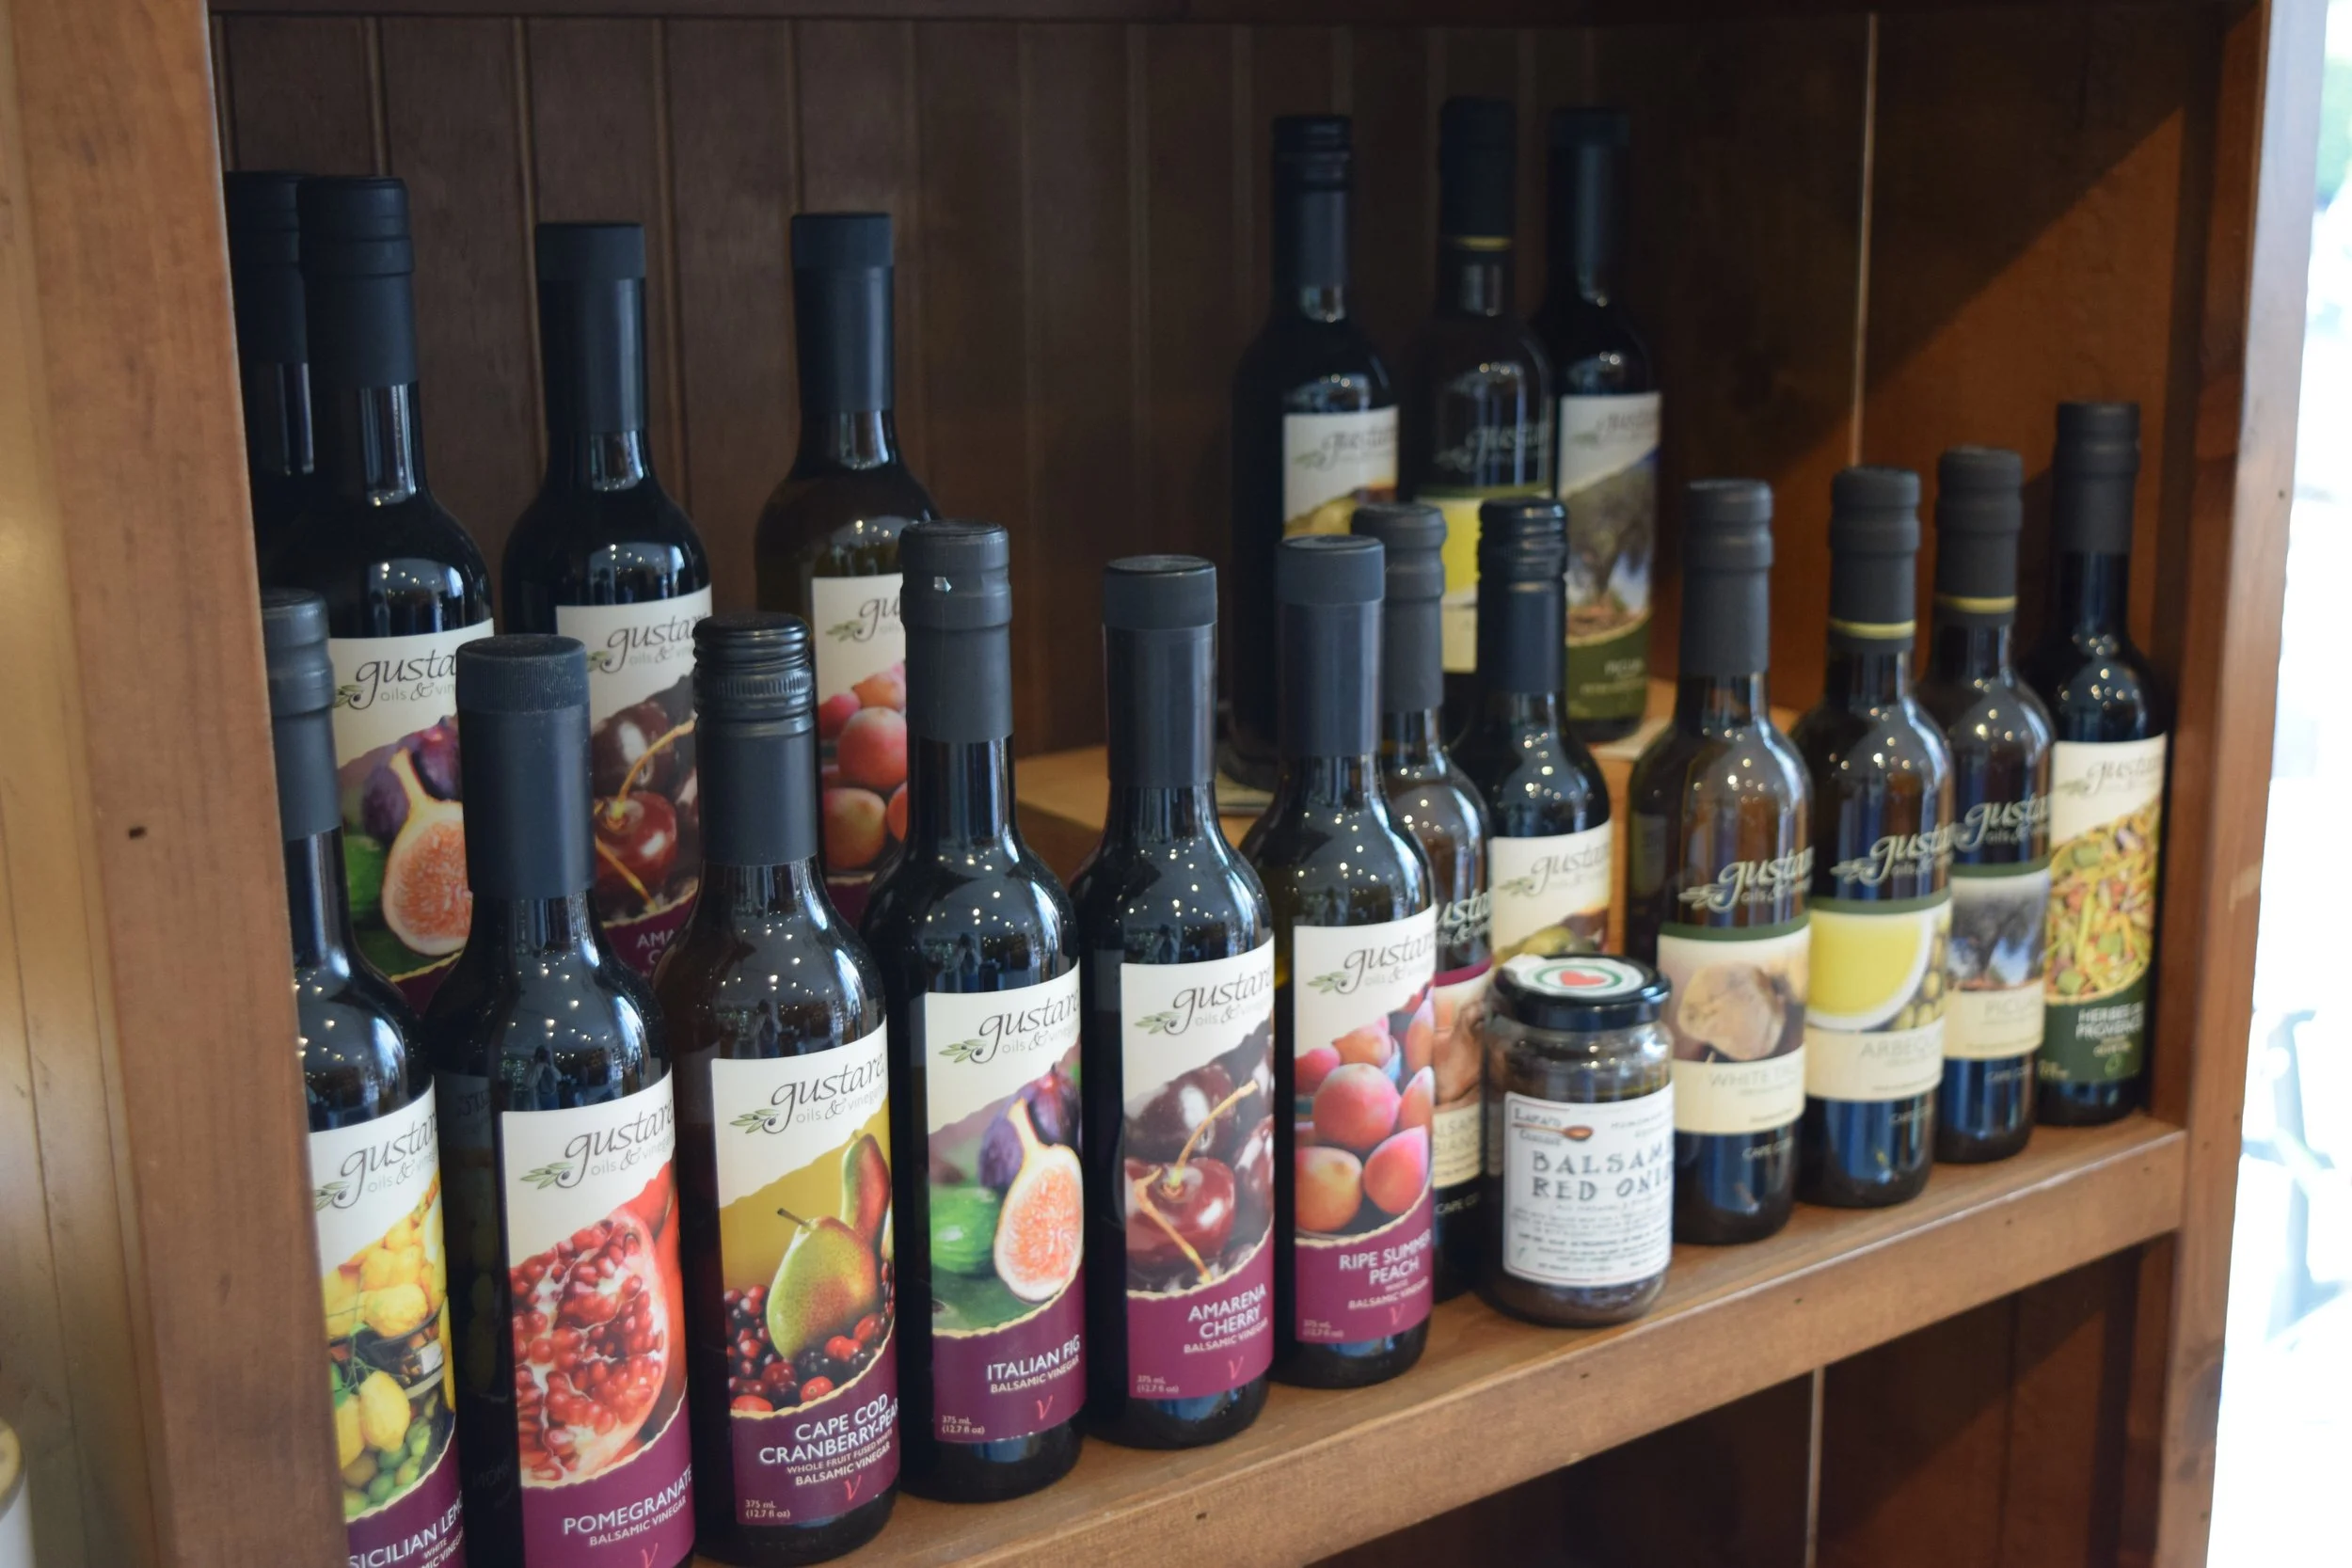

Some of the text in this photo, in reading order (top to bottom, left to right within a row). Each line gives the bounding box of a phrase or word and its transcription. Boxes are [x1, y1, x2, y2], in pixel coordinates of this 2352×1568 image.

[348, 648, 457, 710] gusta
[380, 688, 407, 702] oils
[410, 682, 435, 702] &
[1002, 1038, 1025, 1054] oils
[1028, 1031, 1050, 1051] &
[796, 1108, 821, 1124] oils
[824, 1098, 848, 1120] &
[591, 1158, 617, 1176] oils
[620, 1146, 643, 1171] &
[368, 1175, 393, 1193] oils
[396, 1159, 416, 1185] &
[1532, 1176, 1598, 1202] RED
[1339, 1251, 1379, 1272] RIPE
[1369, 1257, 1421, 1286] PEACH
[1187, 1282, 1267, 1323] AMARENA
[1200, 1304, 1262, 1340] CHERRY
[987, 1334, 1081, 1381] ITALIAN FIG
[1184, 1335, 1237, 1354] BALSAMIC
[991, 1373, 1046, 1394] BALSAMIC
[795, 1393, 889, 1441] CAPE COD
[942, 1415, 956, 1424] 375
[942, 1425, 962, 1434] (12.7
[787, 1462, 824, 1475] WHOLE
[825, 1453, 852, 1469] FRUIT
[853, 1441, 877, 1459] FUSED
[795, 1440, 891, 1487] BALSAMIC VINEGAR
[564, 1463, 692, 1536] POMEGRANATE
[745, 1498, 776, 1509] 375 mL
[745, 1509, 766, 1519] (12.7
[776, 1510, 791, 1519] oz)
[589, 1495, 687, 1547] BALSAMIC VINEGAR
[348, 1523, 437, 1568] SICILIAN
[423, 1537, 447, 1559] WHITE
